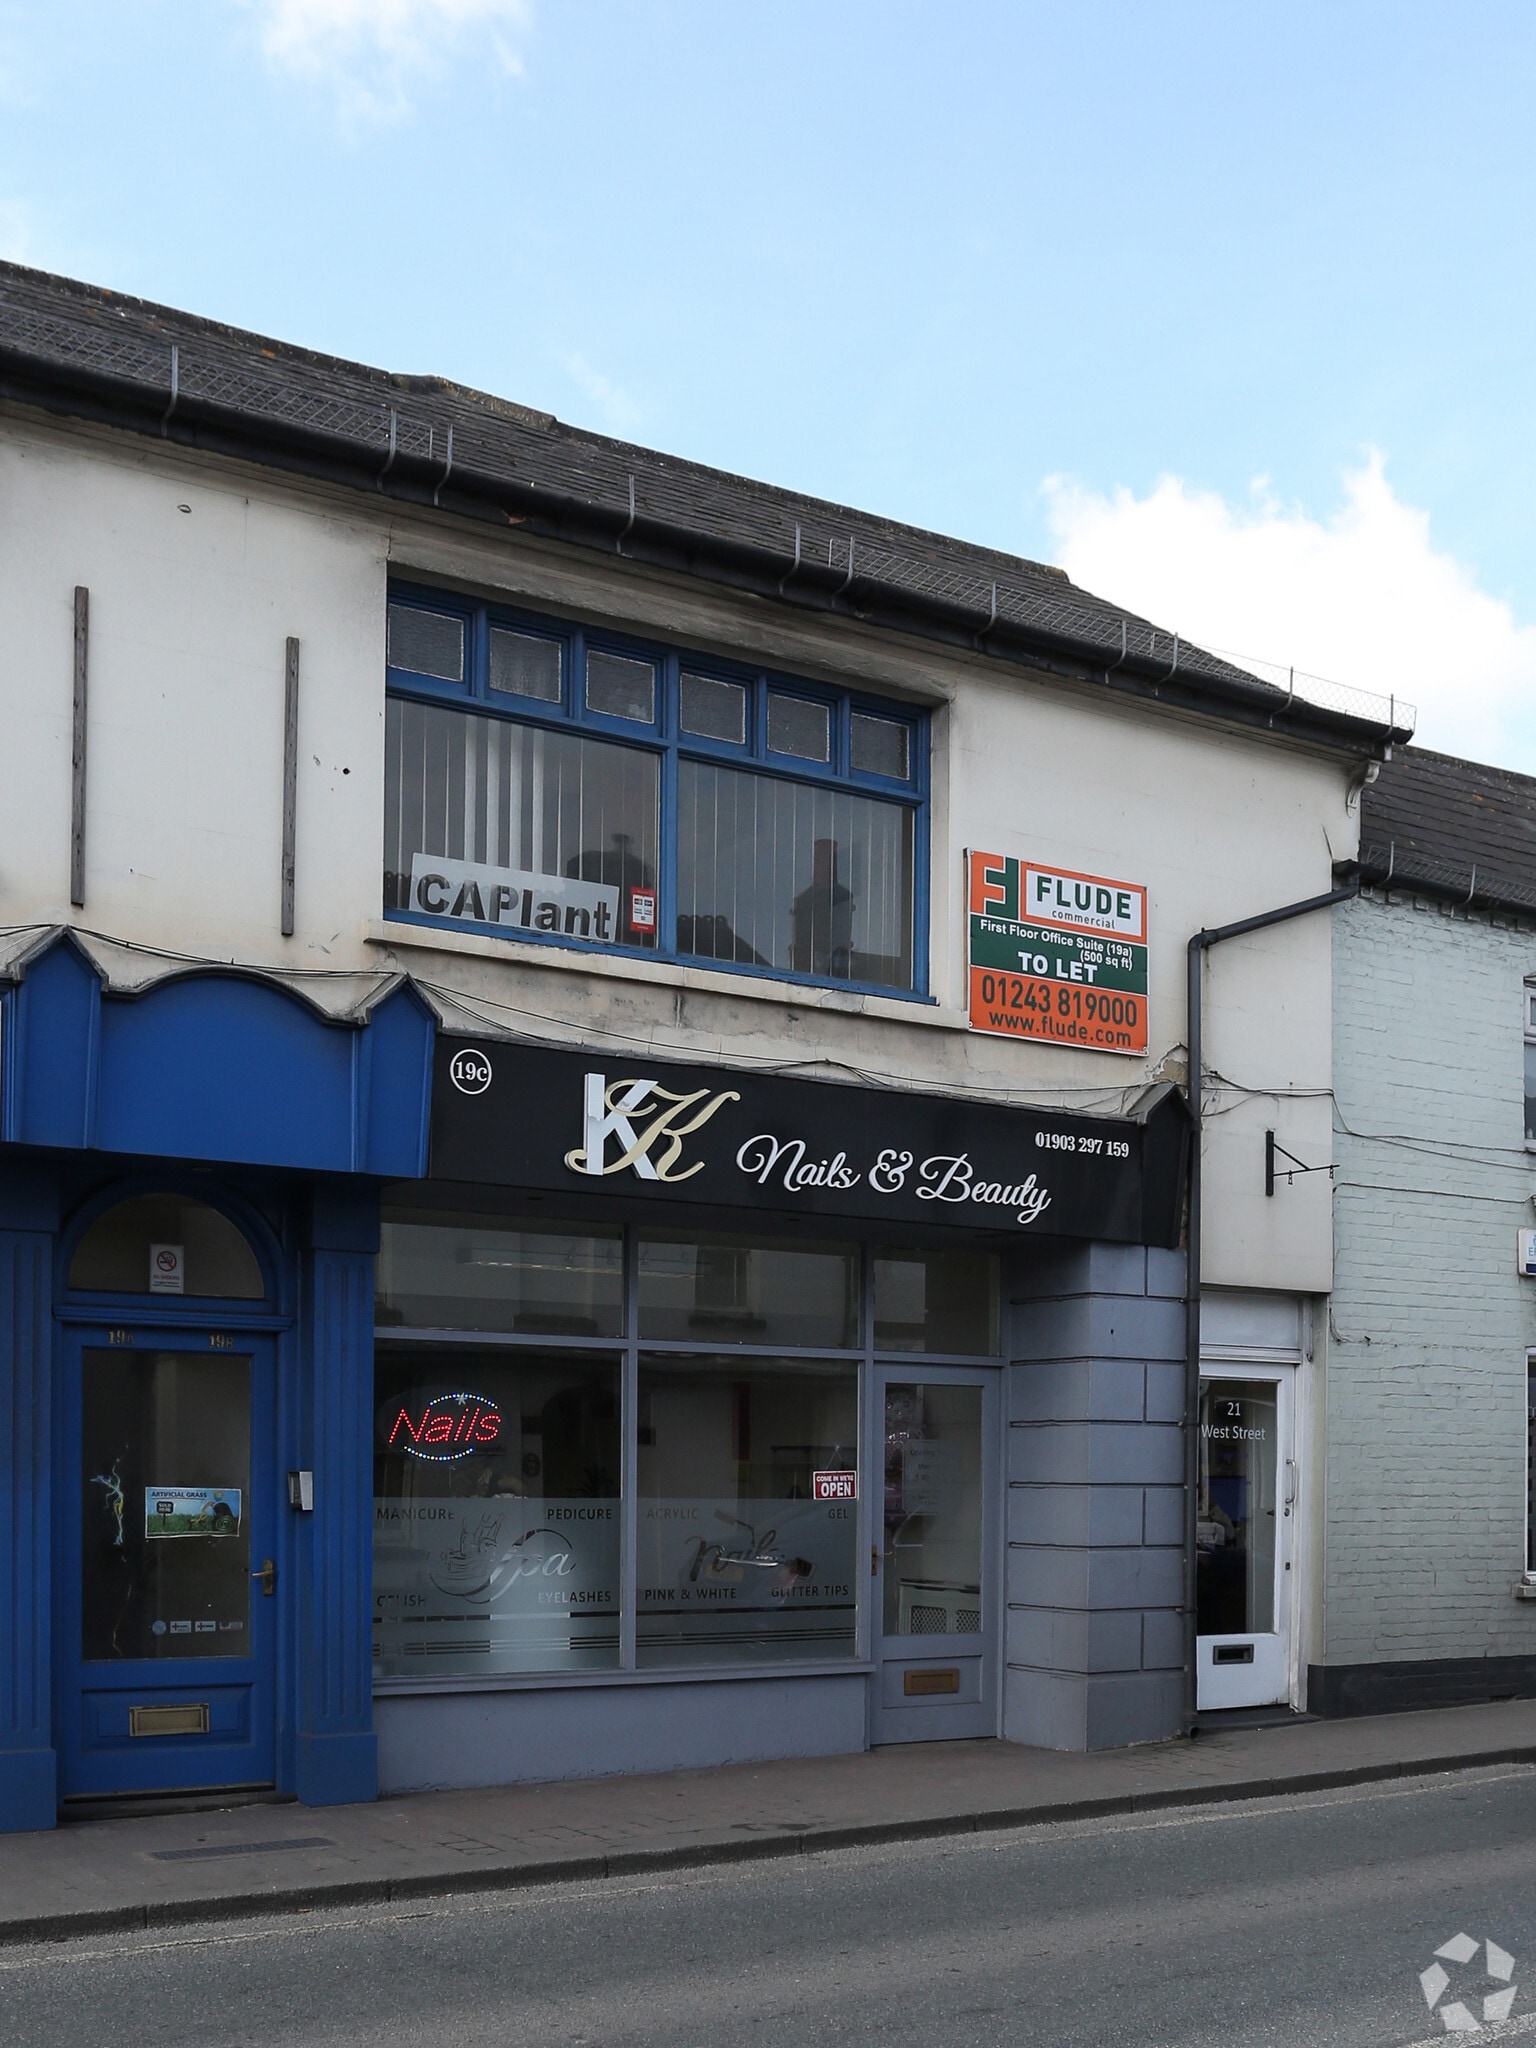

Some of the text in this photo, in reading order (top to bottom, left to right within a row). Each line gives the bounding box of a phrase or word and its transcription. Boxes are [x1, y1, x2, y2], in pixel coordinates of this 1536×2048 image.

[1036, 875, 1131, 919] FLUDE
[1051, 909, 1115, 930] commercial
[980, 919, 1133, 958] First Floor Office Suite (19a)
[1017, 951, 1098, 983] TO LET
[1080, 950, 1133, 971] (500 sq ft)
[982, 974, 1137, 1028] 01243 819000
[989, 1010, 1131, 1047] www.flude.com
[455, 1061, 488, 1083] 19c
[1035, 1131, 1129, 1158] 01903 297 159
[736, 1134, 1052, 1224] Nails & Beauty
[1227, 1402, 1240, 1416] 21
[389, 1407, 502, 1443] Nails
[1201, 1423, 1266, 1440] West Street
[820, 1482, 852, 1497] OPEN
[376, 1508, 454, 1520] MANICURE
[547, 1508, 612, 1520] PEDICURE
[646, 1508, 699, 1520] ACRYLIC
[828, 1508, 848, 1520] GEL
[538, 1591, 612, 1604] EYELASHES
[644, 1588, 737, 1600] PINK & WHITE
[771, 1585, 849, 1598] GLITTER TIPS
